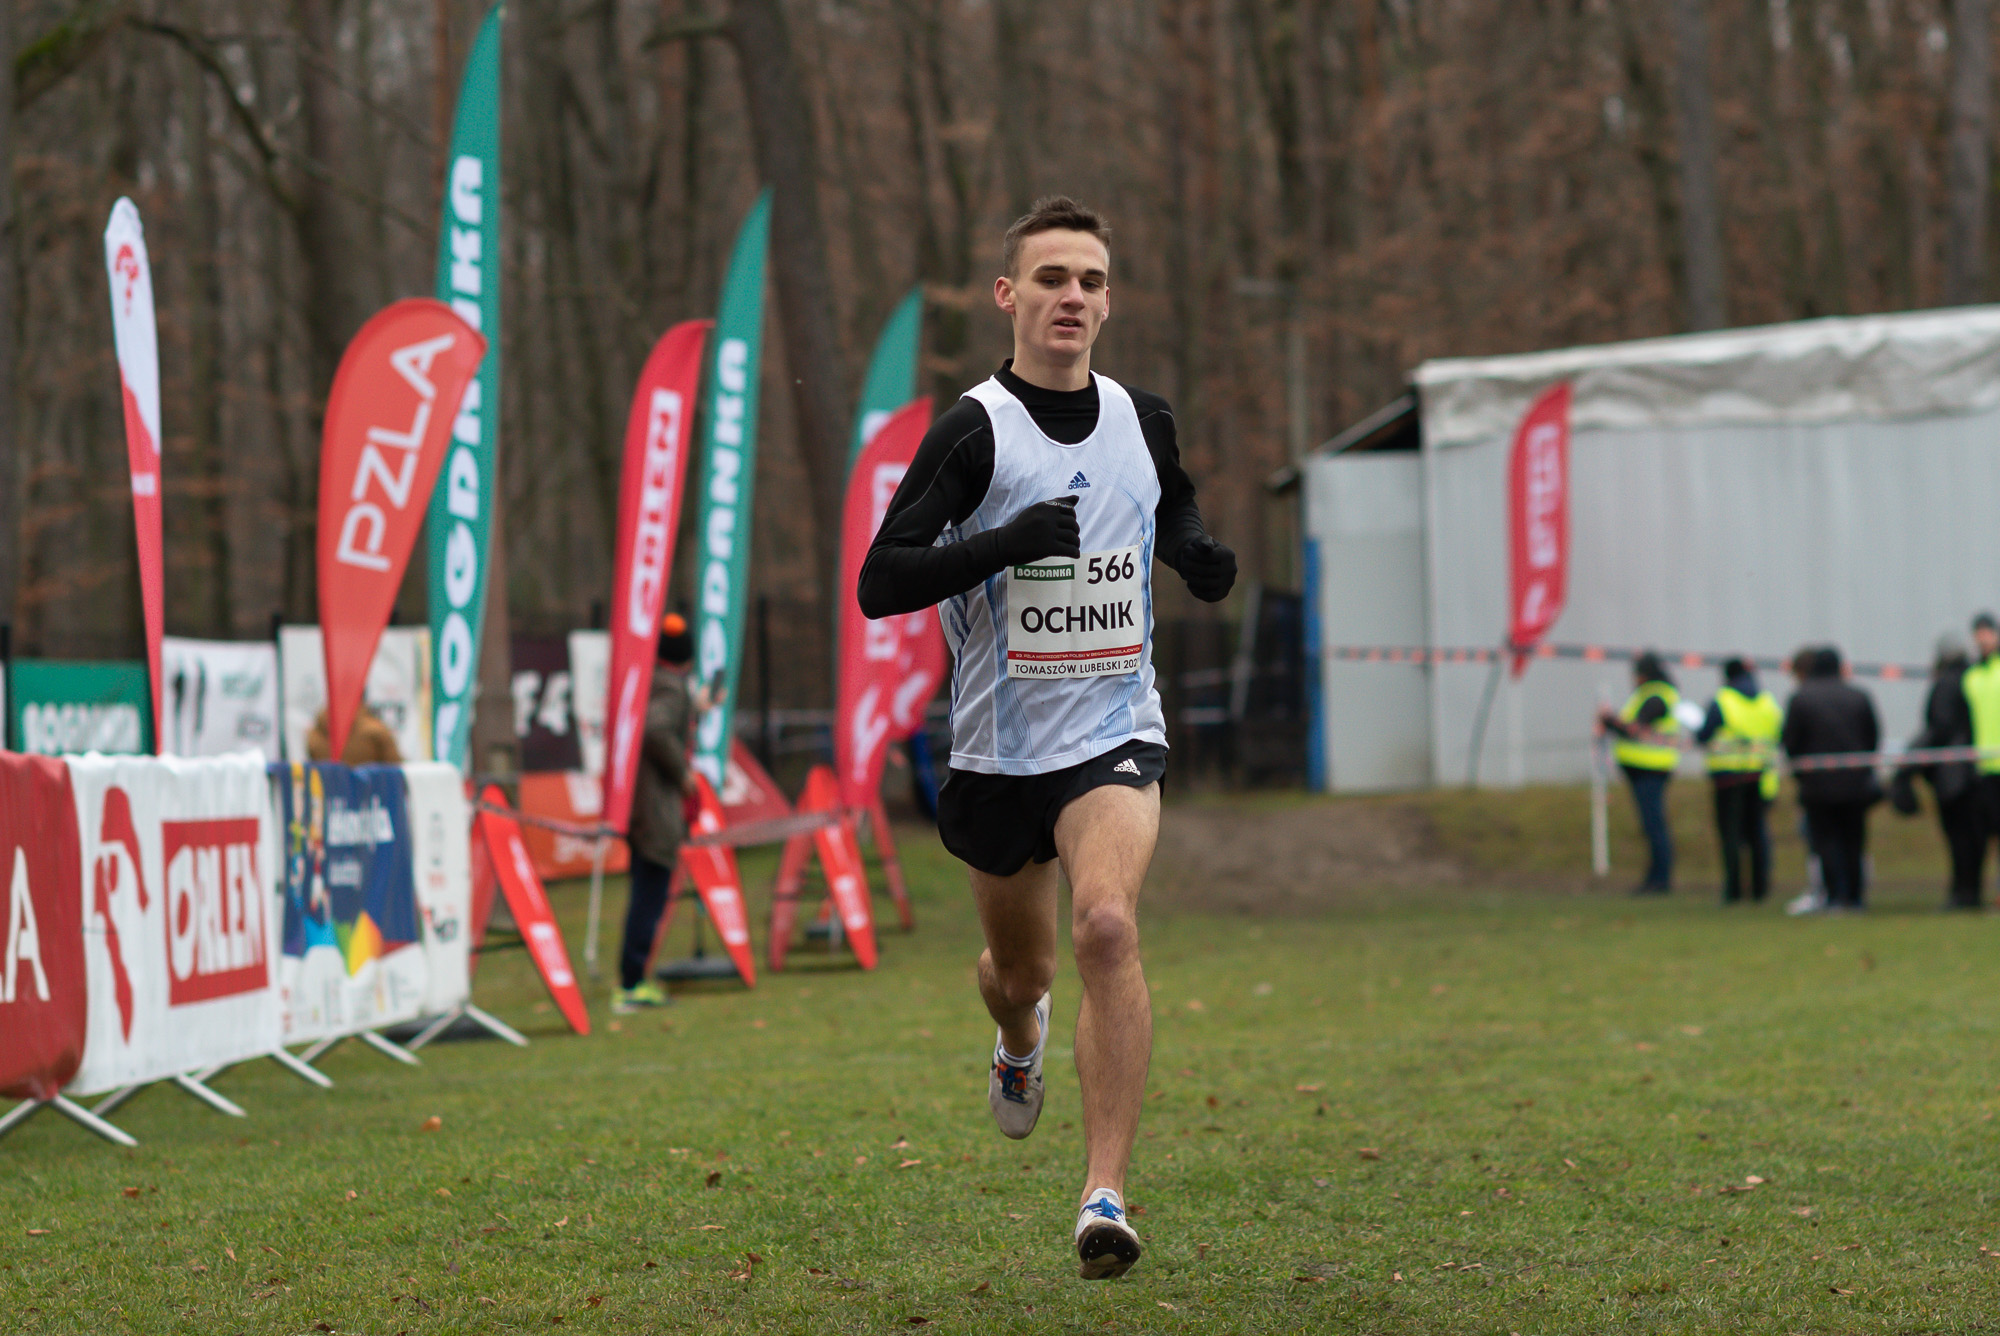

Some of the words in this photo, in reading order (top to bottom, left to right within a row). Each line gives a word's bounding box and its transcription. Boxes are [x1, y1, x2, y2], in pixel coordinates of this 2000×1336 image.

[336, 332, 455, 572] PZLA
[1068, 481, 1091, 490] adidas
[1017, 567, 1072, 578] BOGDANKA
[1087, 552, 1134, 584] 566
[1020, 599, 1134, 633] OCHNIK
[1015, 662, 1077, 675] TOMASZÓW
[1080, 660, 1121, 674] LUBELSKI
[1123, 657, 1140, 669] 202
[1114, 766, 1141, 776] adidas
[0, 844, 50, 1003] A
[168, 843, 264, 981] ORLEN
